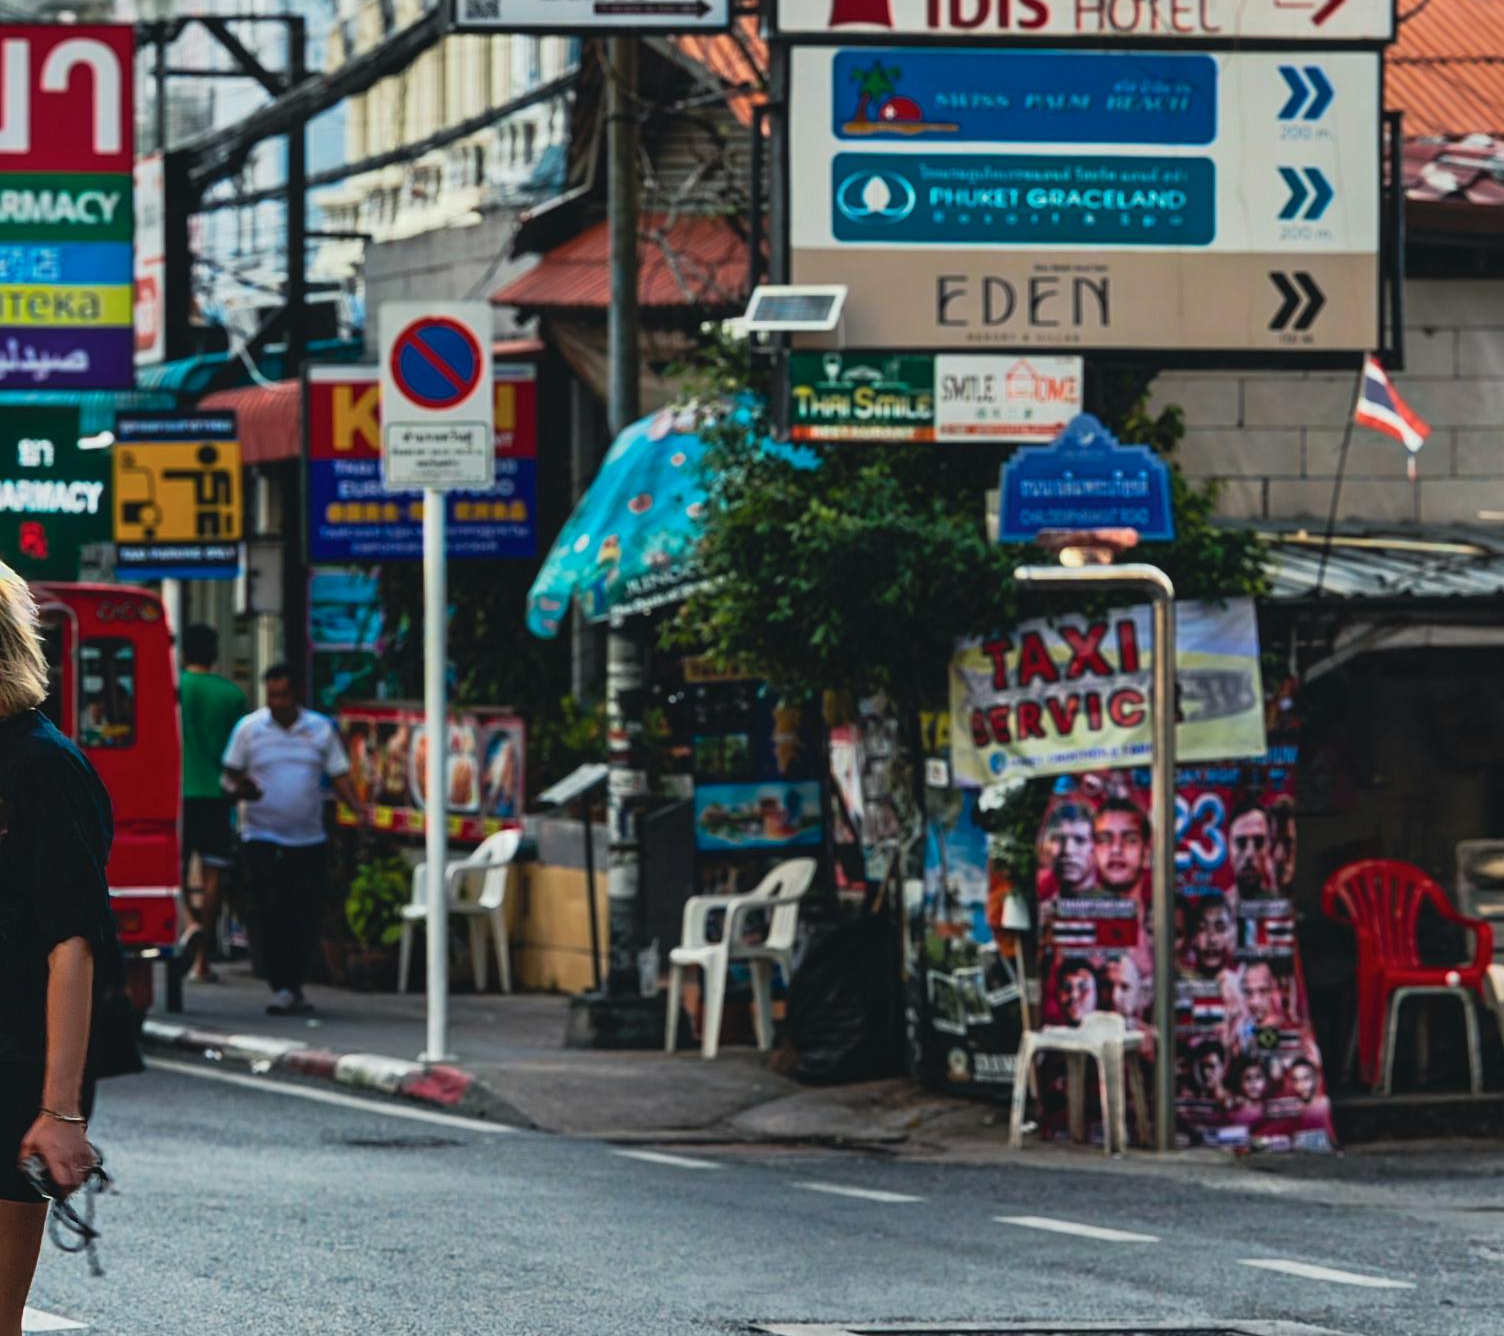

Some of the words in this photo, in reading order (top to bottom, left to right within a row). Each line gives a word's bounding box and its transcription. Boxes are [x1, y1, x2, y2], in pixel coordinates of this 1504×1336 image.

[929, 187, 1018, 208] PHUKET
[1025, 187, 1188, 211] GRACELAND
[936, 275, 1111, 327] EDEN
[982, 619, 1142, 691] TAXI
[969, 687, 1160, 748] SERVIC
